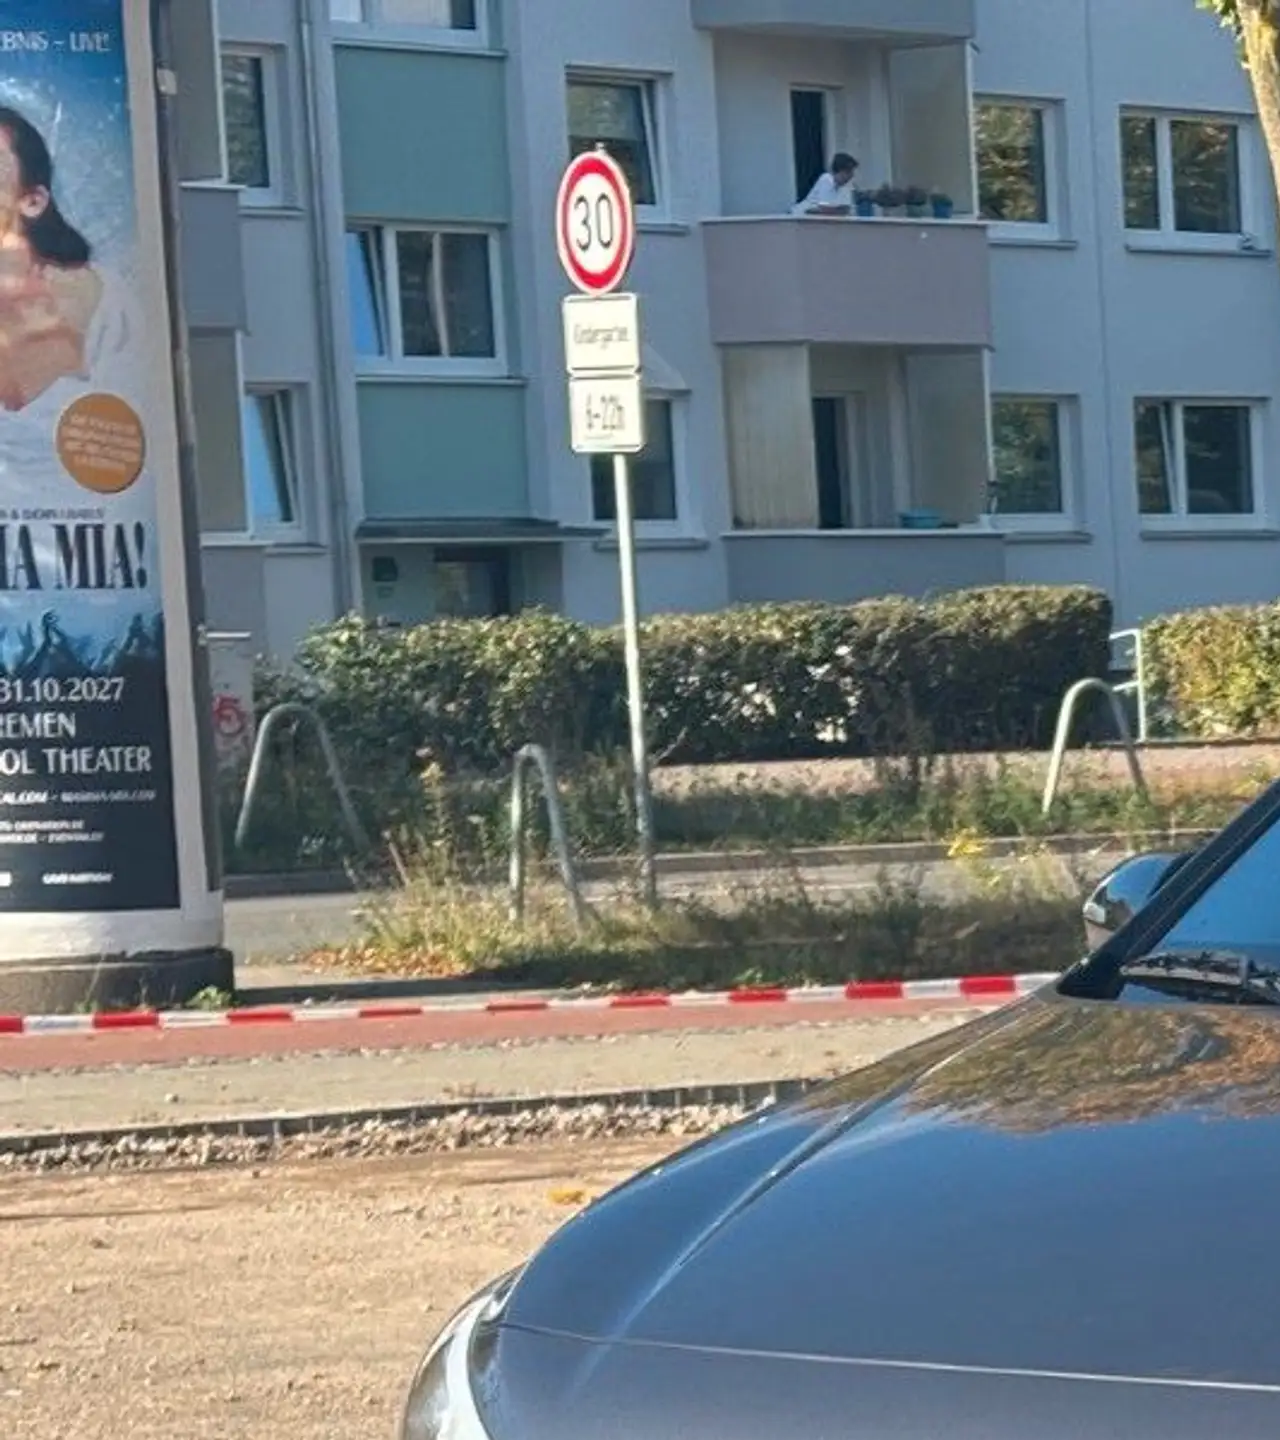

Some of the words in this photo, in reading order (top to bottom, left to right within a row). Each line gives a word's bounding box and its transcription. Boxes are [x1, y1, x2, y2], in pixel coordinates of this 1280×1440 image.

[574, 193, 613, 251] 30
[53, 521, 147, 589] MIA!
[0, 676, 125, 704] 31.10.2027
[42, 745, 153, 774] THEATER
